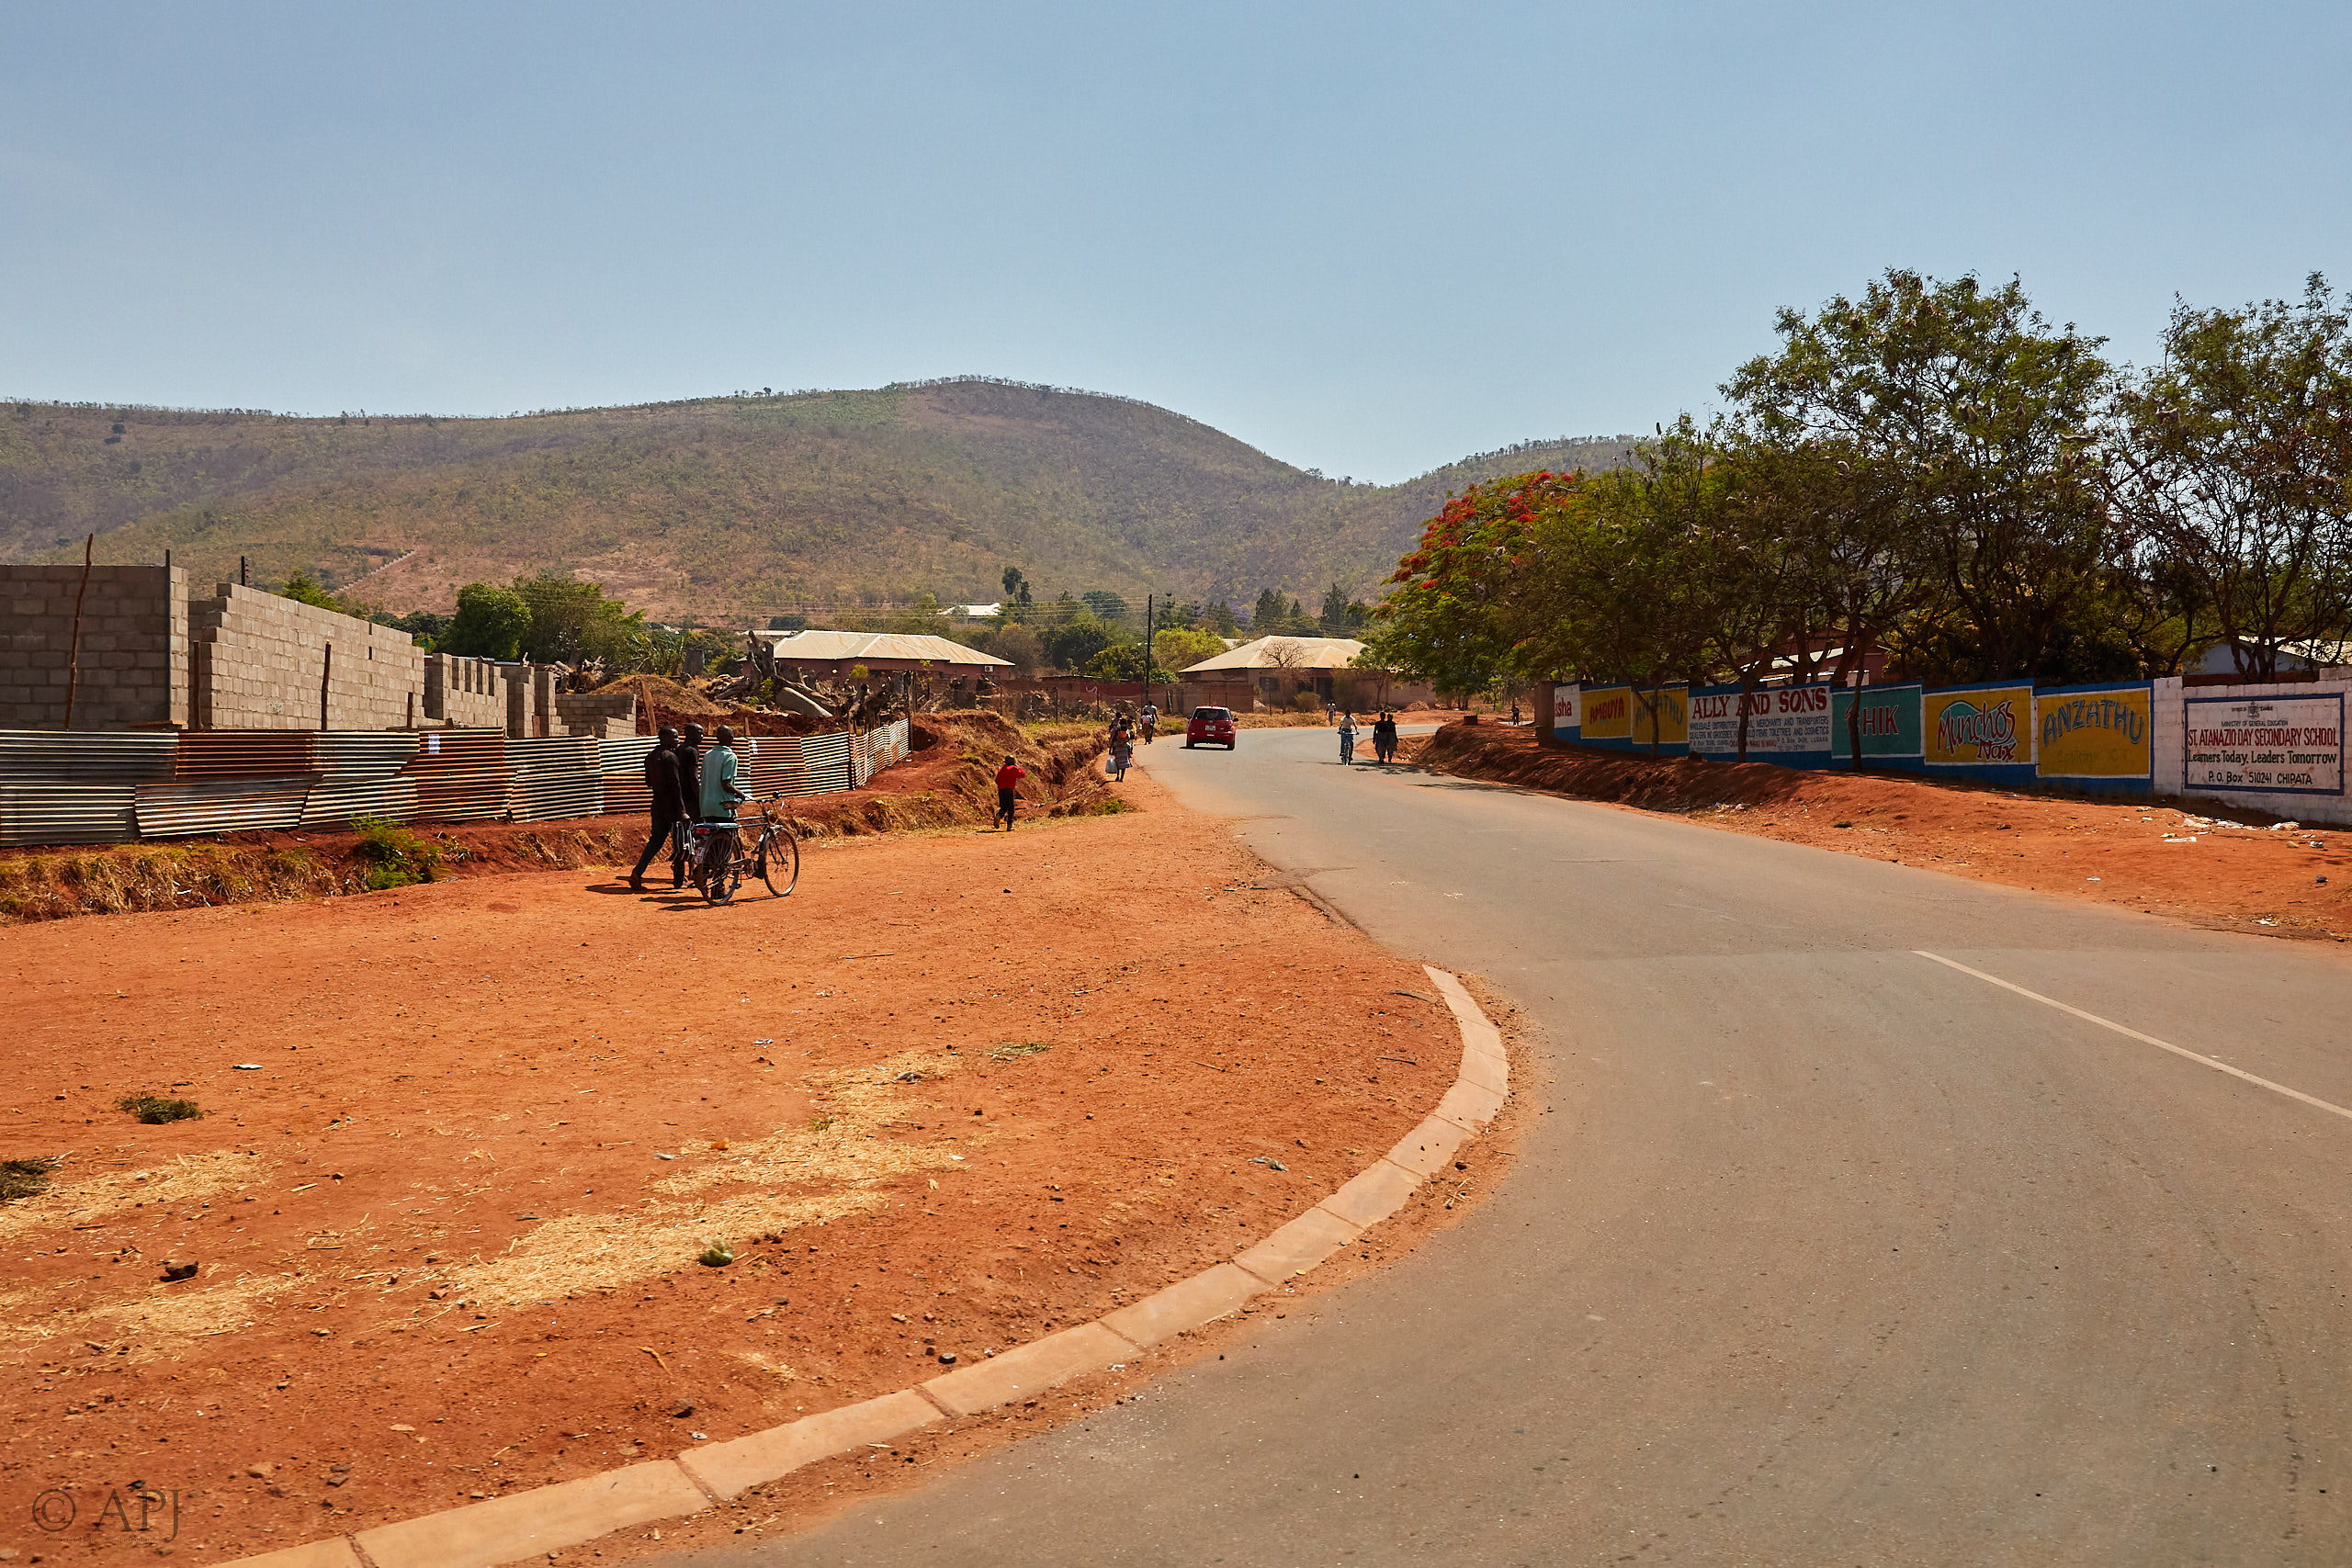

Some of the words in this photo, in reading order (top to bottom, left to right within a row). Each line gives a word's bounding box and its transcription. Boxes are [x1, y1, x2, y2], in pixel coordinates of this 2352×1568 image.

[1692, 695, 1730, 719] ALLY
[1779, 688, 1826, 713] SONS
[2042, 699, 2143, 747] ANZATHU
[2199, 728, 2236, 746] ATANAZIO
[2238, 728, 2253, 746] DAY
[2255, 728, 2302, 746] SECONDARY
[2304, 727, 2338, 746] SCHOOL
[2251, 750, 2285, 763] Leaders
[2288, 750, 2337, 764] Tomorrow
[2209, 771, 2215, 781] P.
[2216, 772, 2224, 782] O.
[2226, 772, 2243, 783] Box
[2248, 773, 2272, 784] 510241
[2277, 773, 2312, 784] CHIPATA
